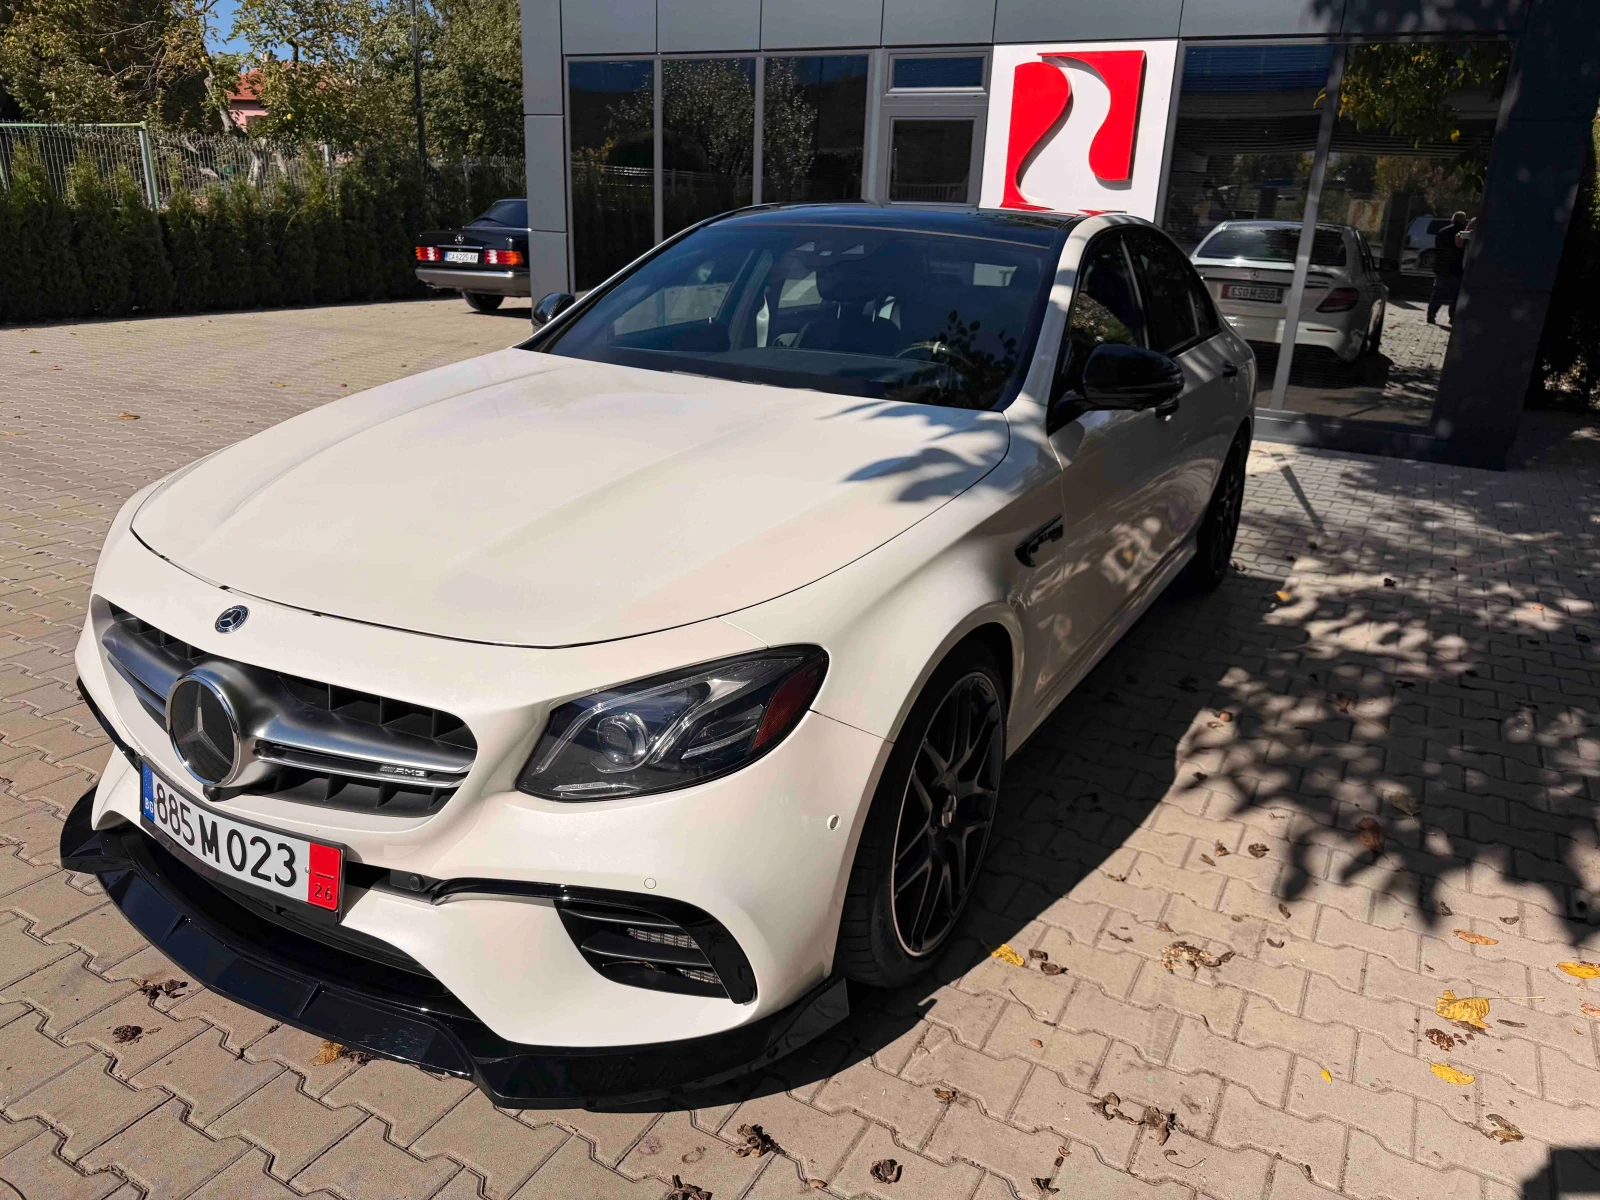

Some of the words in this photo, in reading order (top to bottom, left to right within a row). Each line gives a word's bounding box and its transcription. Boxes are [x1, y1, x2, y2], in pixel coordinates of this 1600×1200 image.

[144, 797, 154, 813] BG
[156, 783, 195, 846] 885
[198, 814, 221, 864] M
[226, 828, 297, 888] 023
[314, 883, 333, 901] 26
